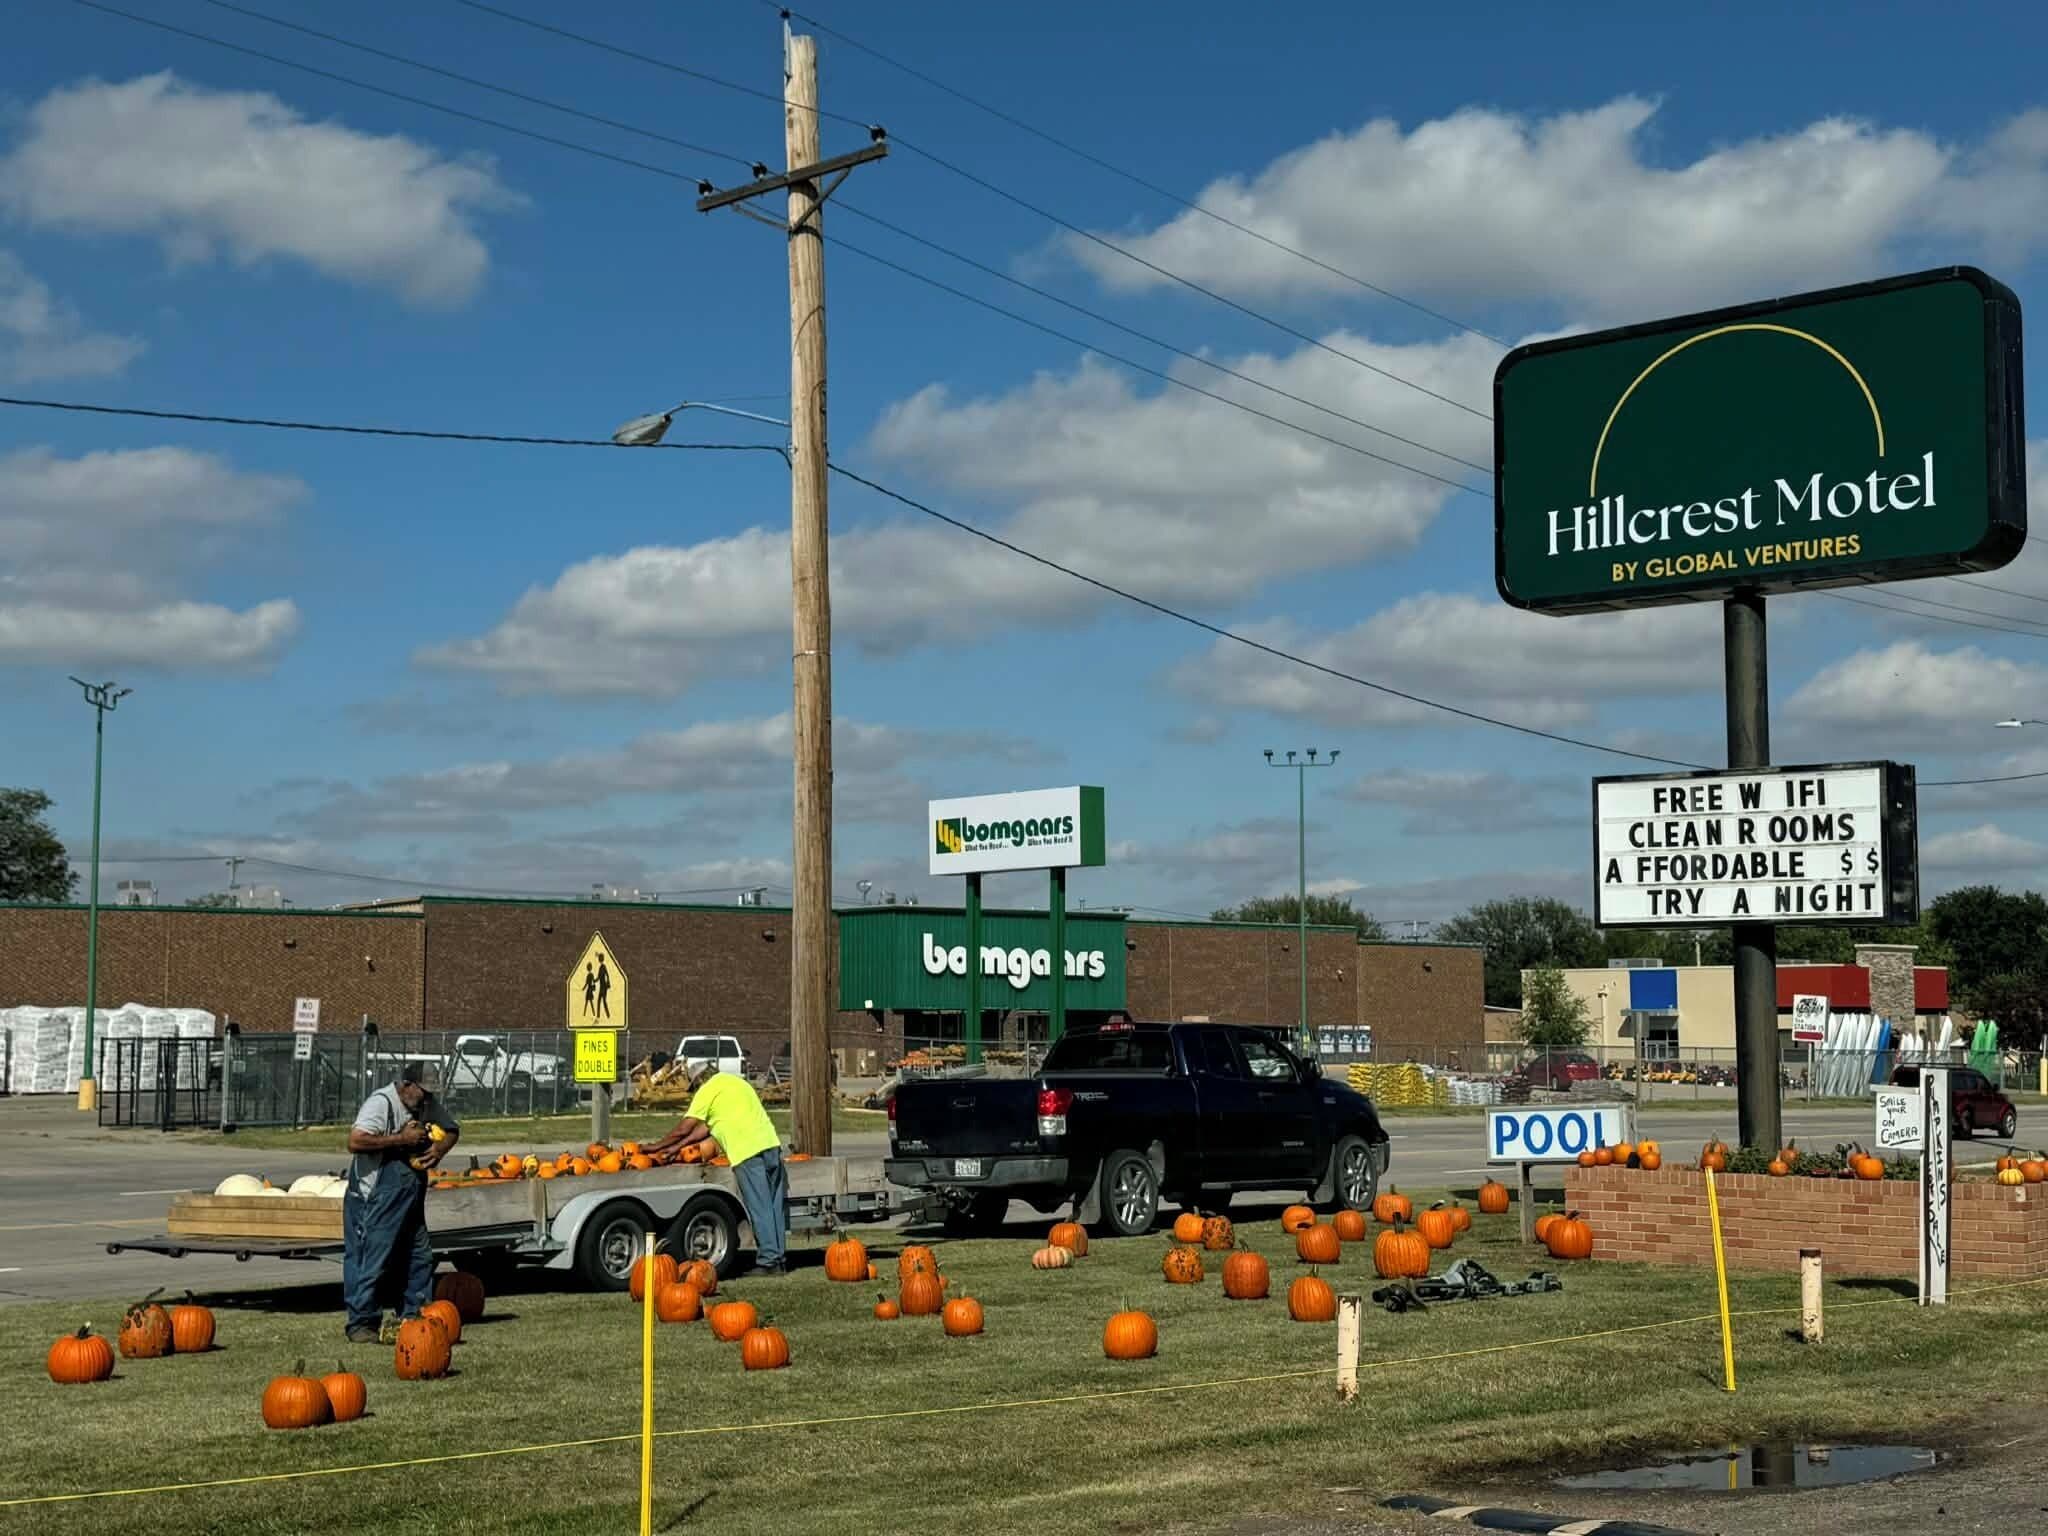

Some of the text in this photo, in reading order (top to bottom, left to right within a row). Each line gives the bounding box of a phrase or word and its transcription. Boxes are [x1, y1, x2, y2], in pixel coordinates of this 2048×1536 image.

[1547, 451, 1936, 555] Hillcrest Motel
[1612, 534, 1861, 582] BY GLOBAL VENTURES
[1653, 783, 1723, 813] FREE
[962, 816, 1073, 847] bomgaars
[1628, 818, 1722, 848] CLEAN
[1647, 883, 1876, 915] TRY A NIGHT
[583, 1040, 609, 1053] FINES
[577, 1060, 613, 1073] DOUBLE
